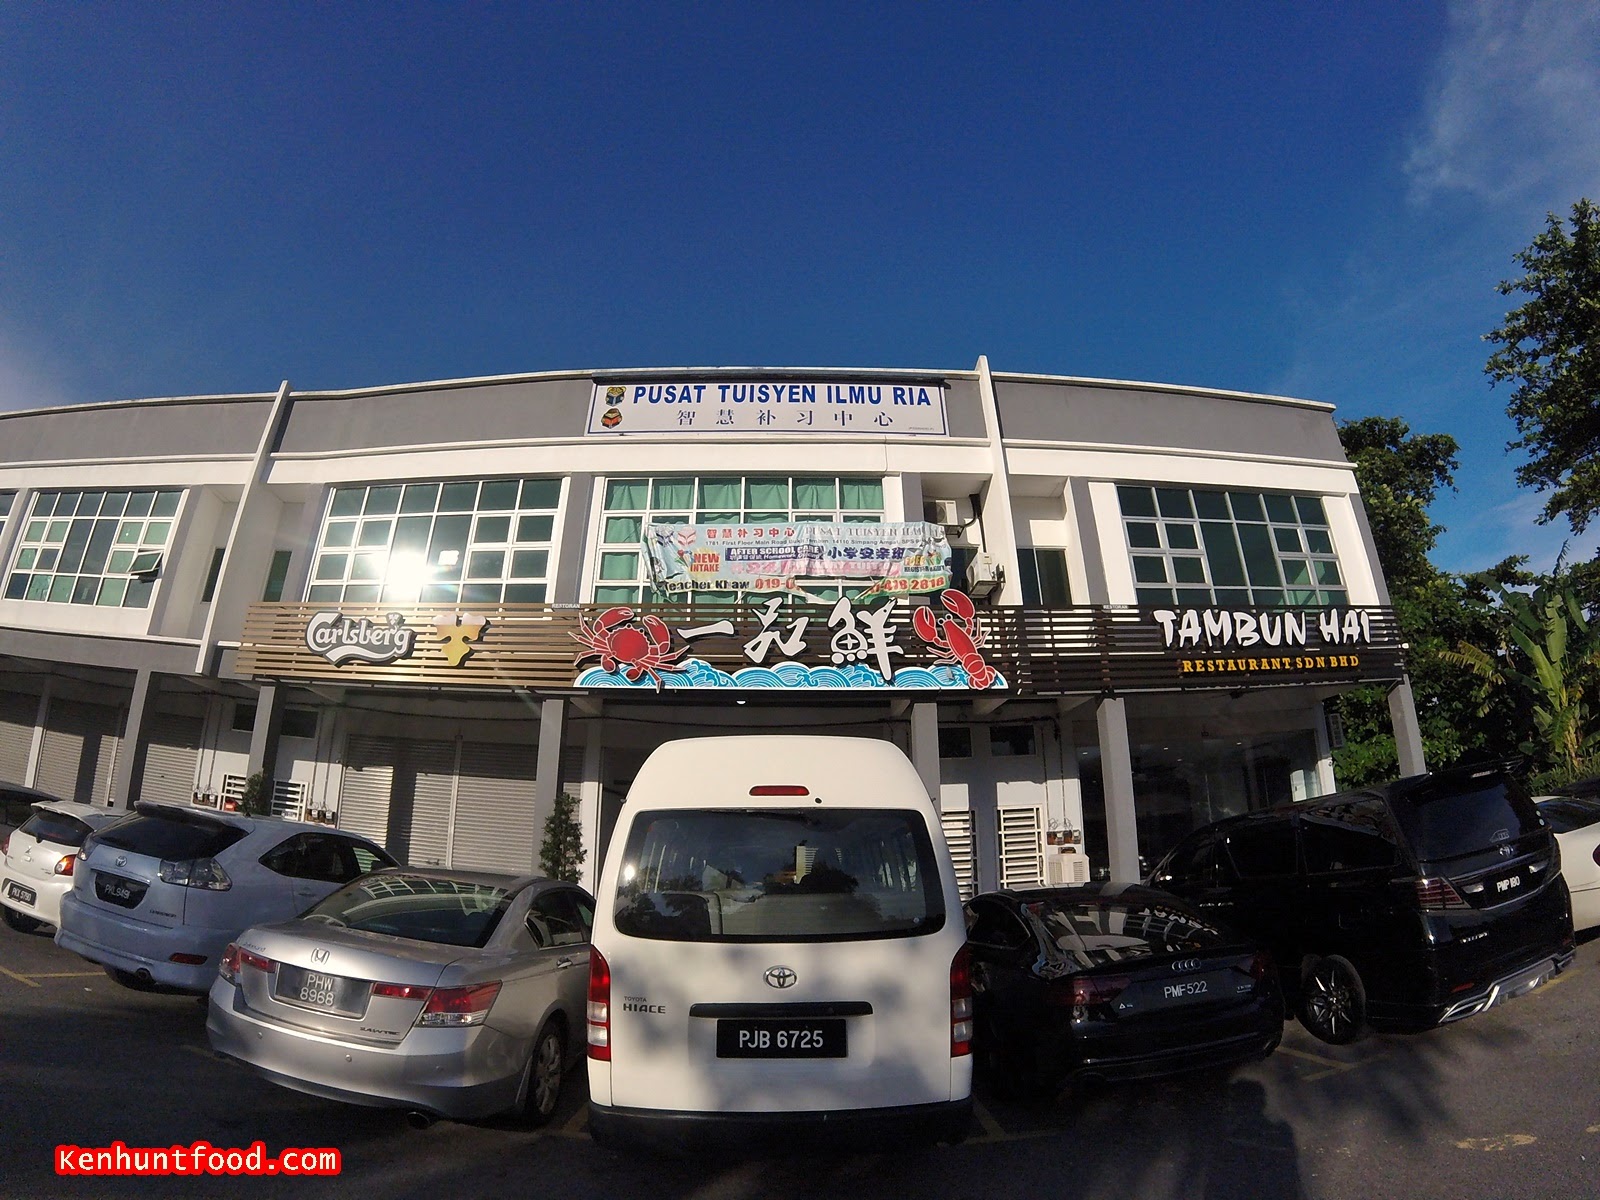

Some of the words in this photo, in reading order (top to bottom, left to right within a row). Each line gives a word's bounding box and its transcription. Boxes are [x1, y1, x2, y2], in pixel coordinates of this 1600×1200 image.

[633, 385, 706, 404] PUSAT
[718, 384, 816, 403] TUISYEN
[827, 385, 882, 405] ILMU
[893, 386, 931, 406] RIA
[677, 409, 893, 426] 智慧补习中心
[706, 528, 795, 538] 智慧补习中心
[694, 553, 719, 563] NEW
[731, 548, 758, 556] AFTER
[760, 547, 796, 555] SCHOOL
[690, 564, 720, 572] INTAKE
[306, 610, 414, 661] Carlsberg
[1153, 608, 1307, 648] TAMBUN
[1319, 608, 1371, 644] HAI
[1182, 658, 1293, 673] RESTAURANT
[1296, 656, 1325, 669] SDN
[1330, 655, 1360, 667] BHD
[306, 973, 333, 991] PHW
[1163, 981, 1208, 999] PMF522
[299, 988, 335, 1007] 8968
[622, 1003, 666, 1014] HIACE
[739, 1030, 771, 1049] PJB
[776, 1030, 824, 1048] 6725
